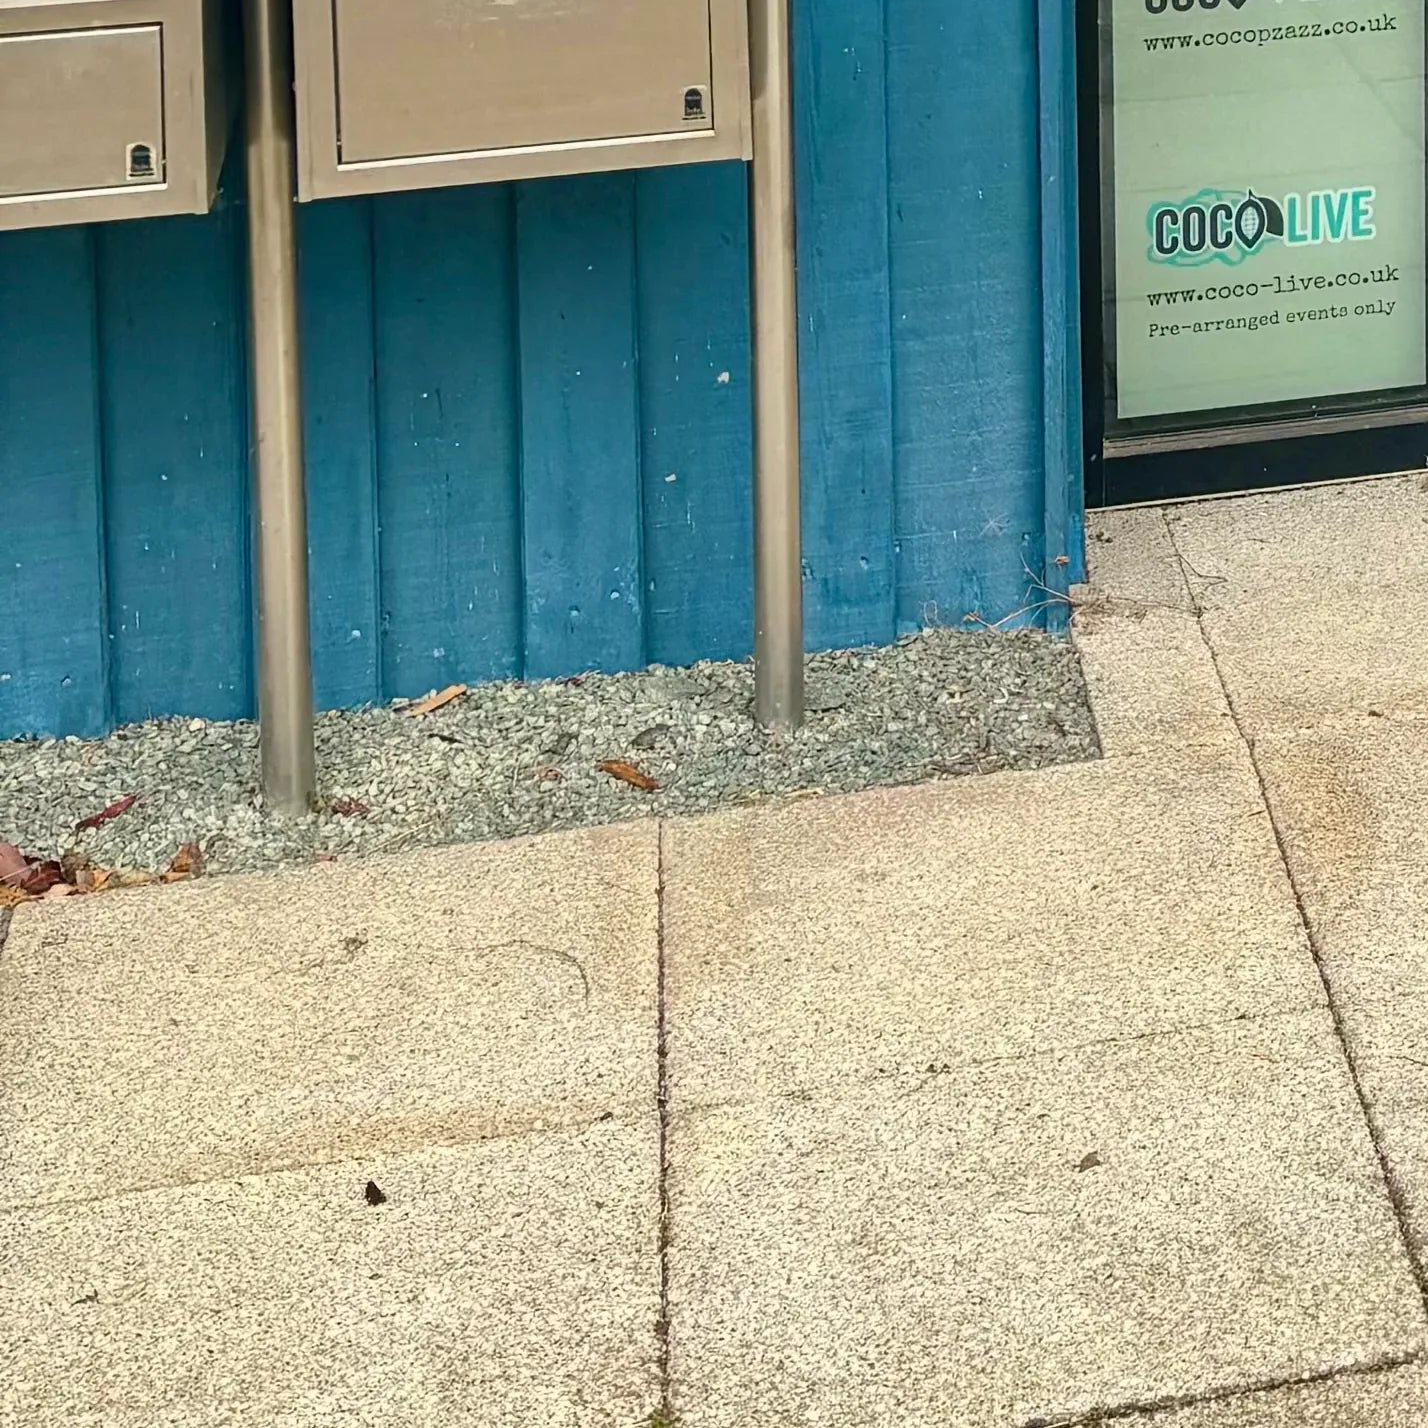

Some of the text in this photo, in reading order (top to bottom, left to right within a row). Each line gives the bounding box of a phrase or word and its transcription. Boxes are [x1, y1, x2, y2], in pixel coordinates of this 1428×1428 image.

[1144, 13, 1397, 52] www.cocopzazz.co.uk
[1285, 188, 1375, 243] LIVE
[1147, 265, 1399, 307] www.coco-live.co.uk
[1148, 300, 1396, 340] Pre-arranged events only
